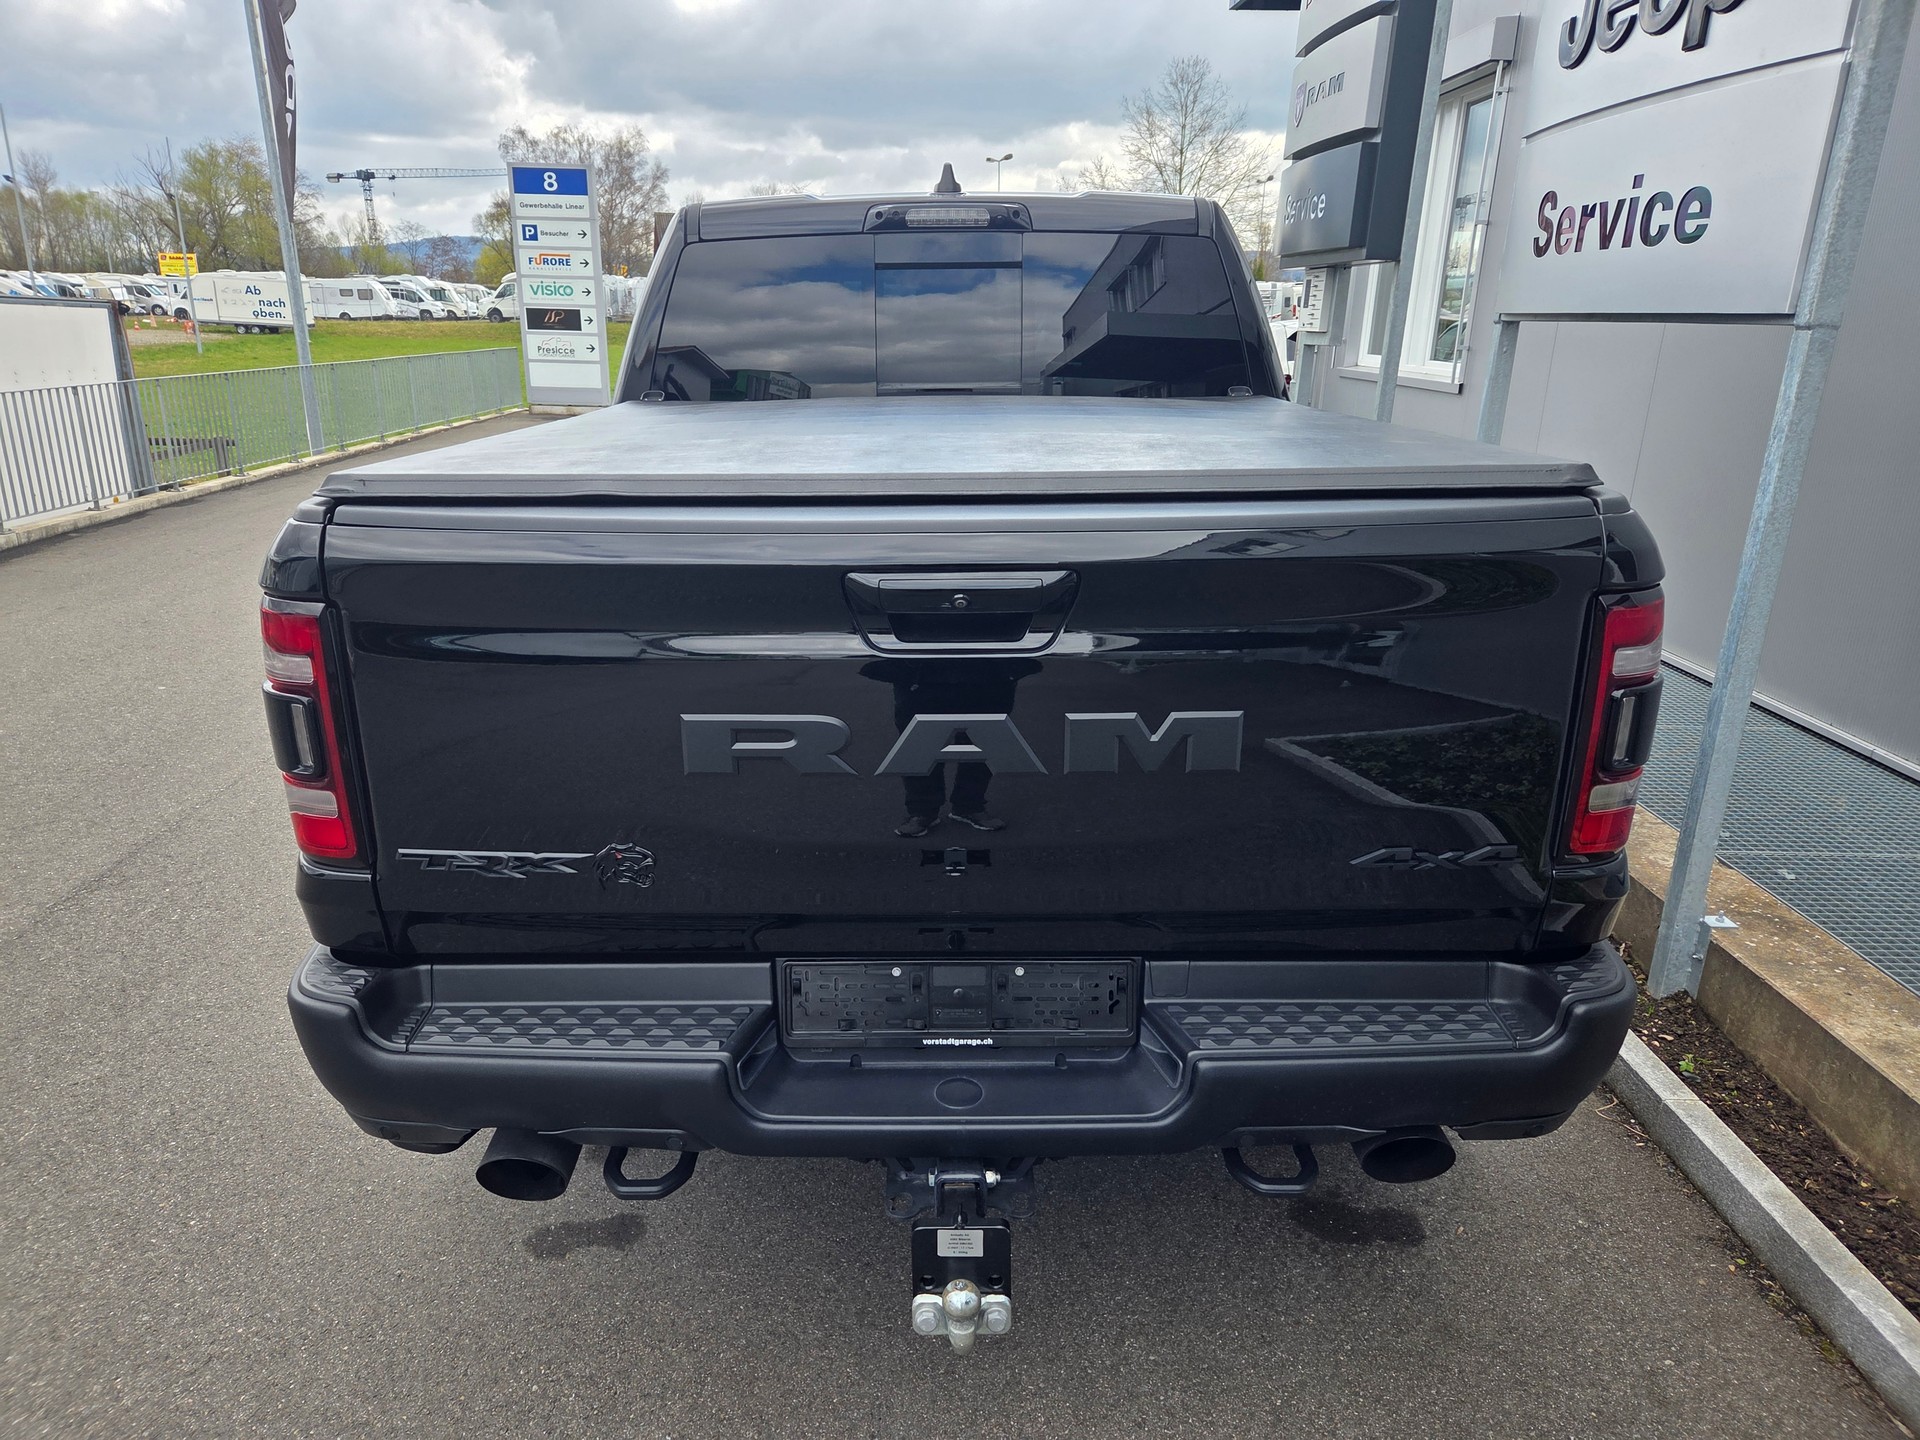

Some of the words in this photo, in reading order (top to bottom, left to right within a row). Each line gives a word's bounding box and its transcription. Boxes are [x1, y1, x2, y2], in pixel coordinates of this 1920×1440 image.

[1306, 71, 1345, 108] RAM
[543, 171, 558, 192] 8
[519, 201, 563, 210] Gewerbehalle
[565, 202, 585, 210] Linear
[1283, 189, 1327, 225] Service
[1532, 173, 1713, 259] Service
[524, 226, 535, 239] P
[528, 254, 572, 267] FURORE
[245, 285, 262, 296] Ab
[529, 281, 574, 297] visico
[258, 298, 286, 308] nach
[252, 308, 286, 319] oben.
[537, 345, 575, 355] Presicce
[680, 710, 1245, 776] RAM
[922, 1037, 993, 1047] vorstadtgarage.ch
